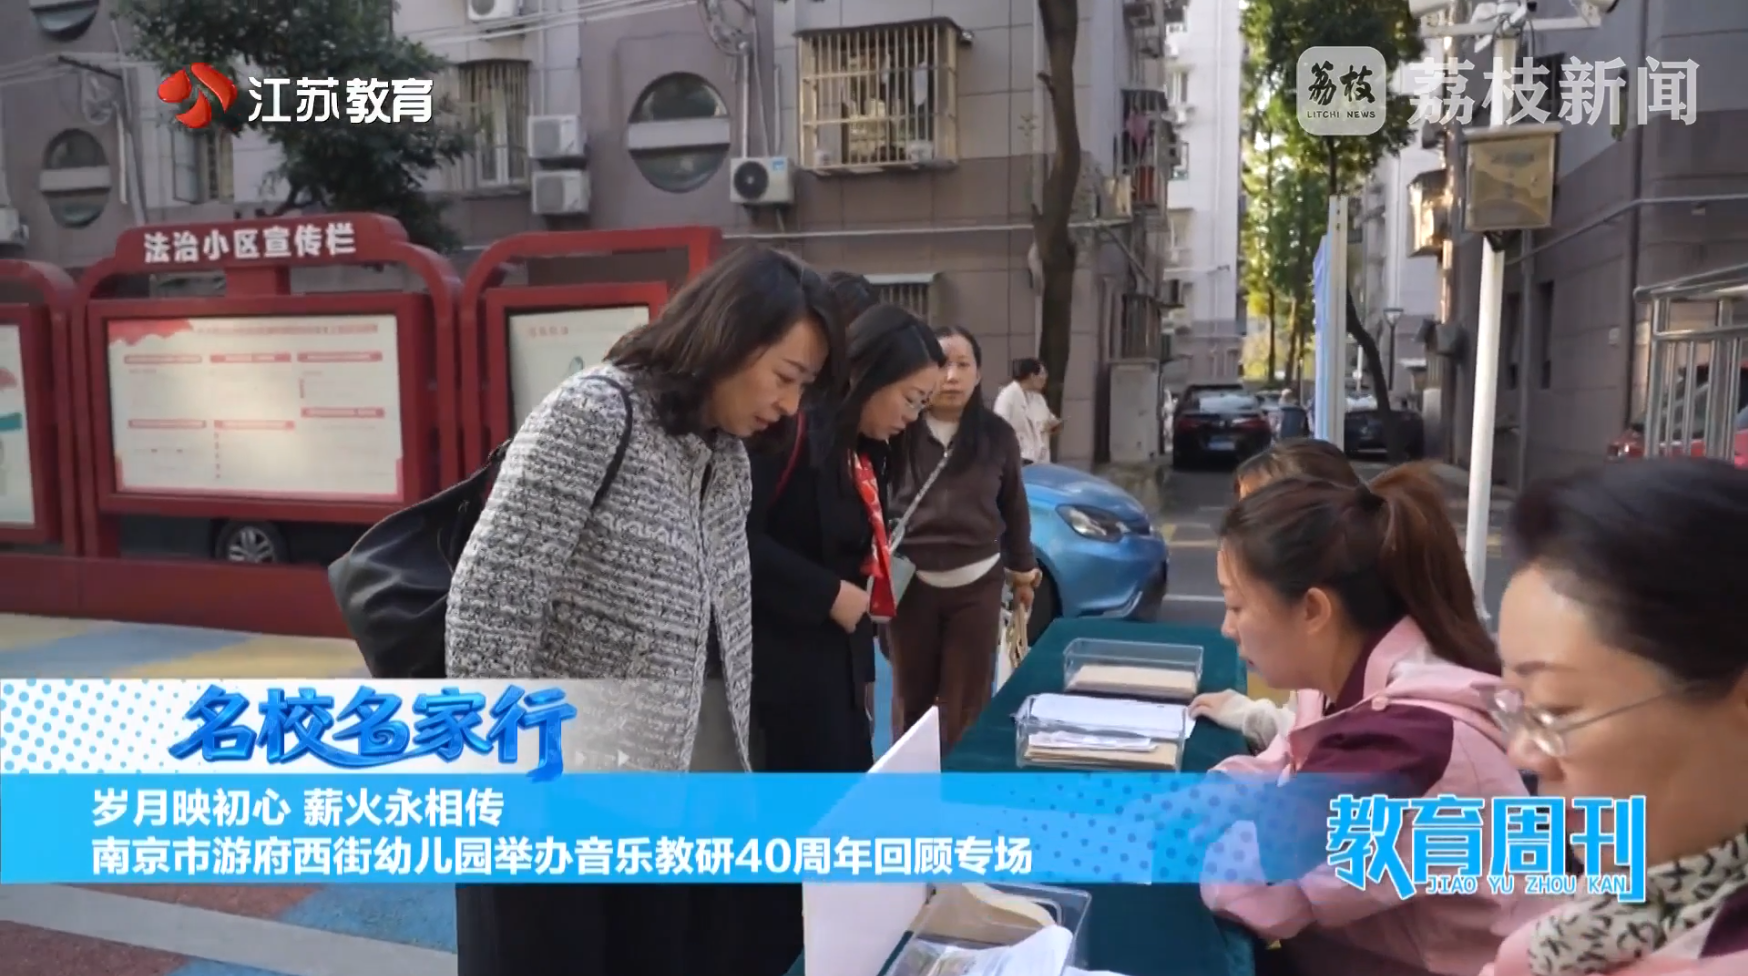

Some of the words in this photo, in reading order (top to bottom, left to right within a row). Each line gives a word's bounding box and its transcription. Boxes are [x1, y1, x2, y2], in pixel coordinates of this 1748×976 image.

[144, 222, 356, 263] 法治小区宣传栏
